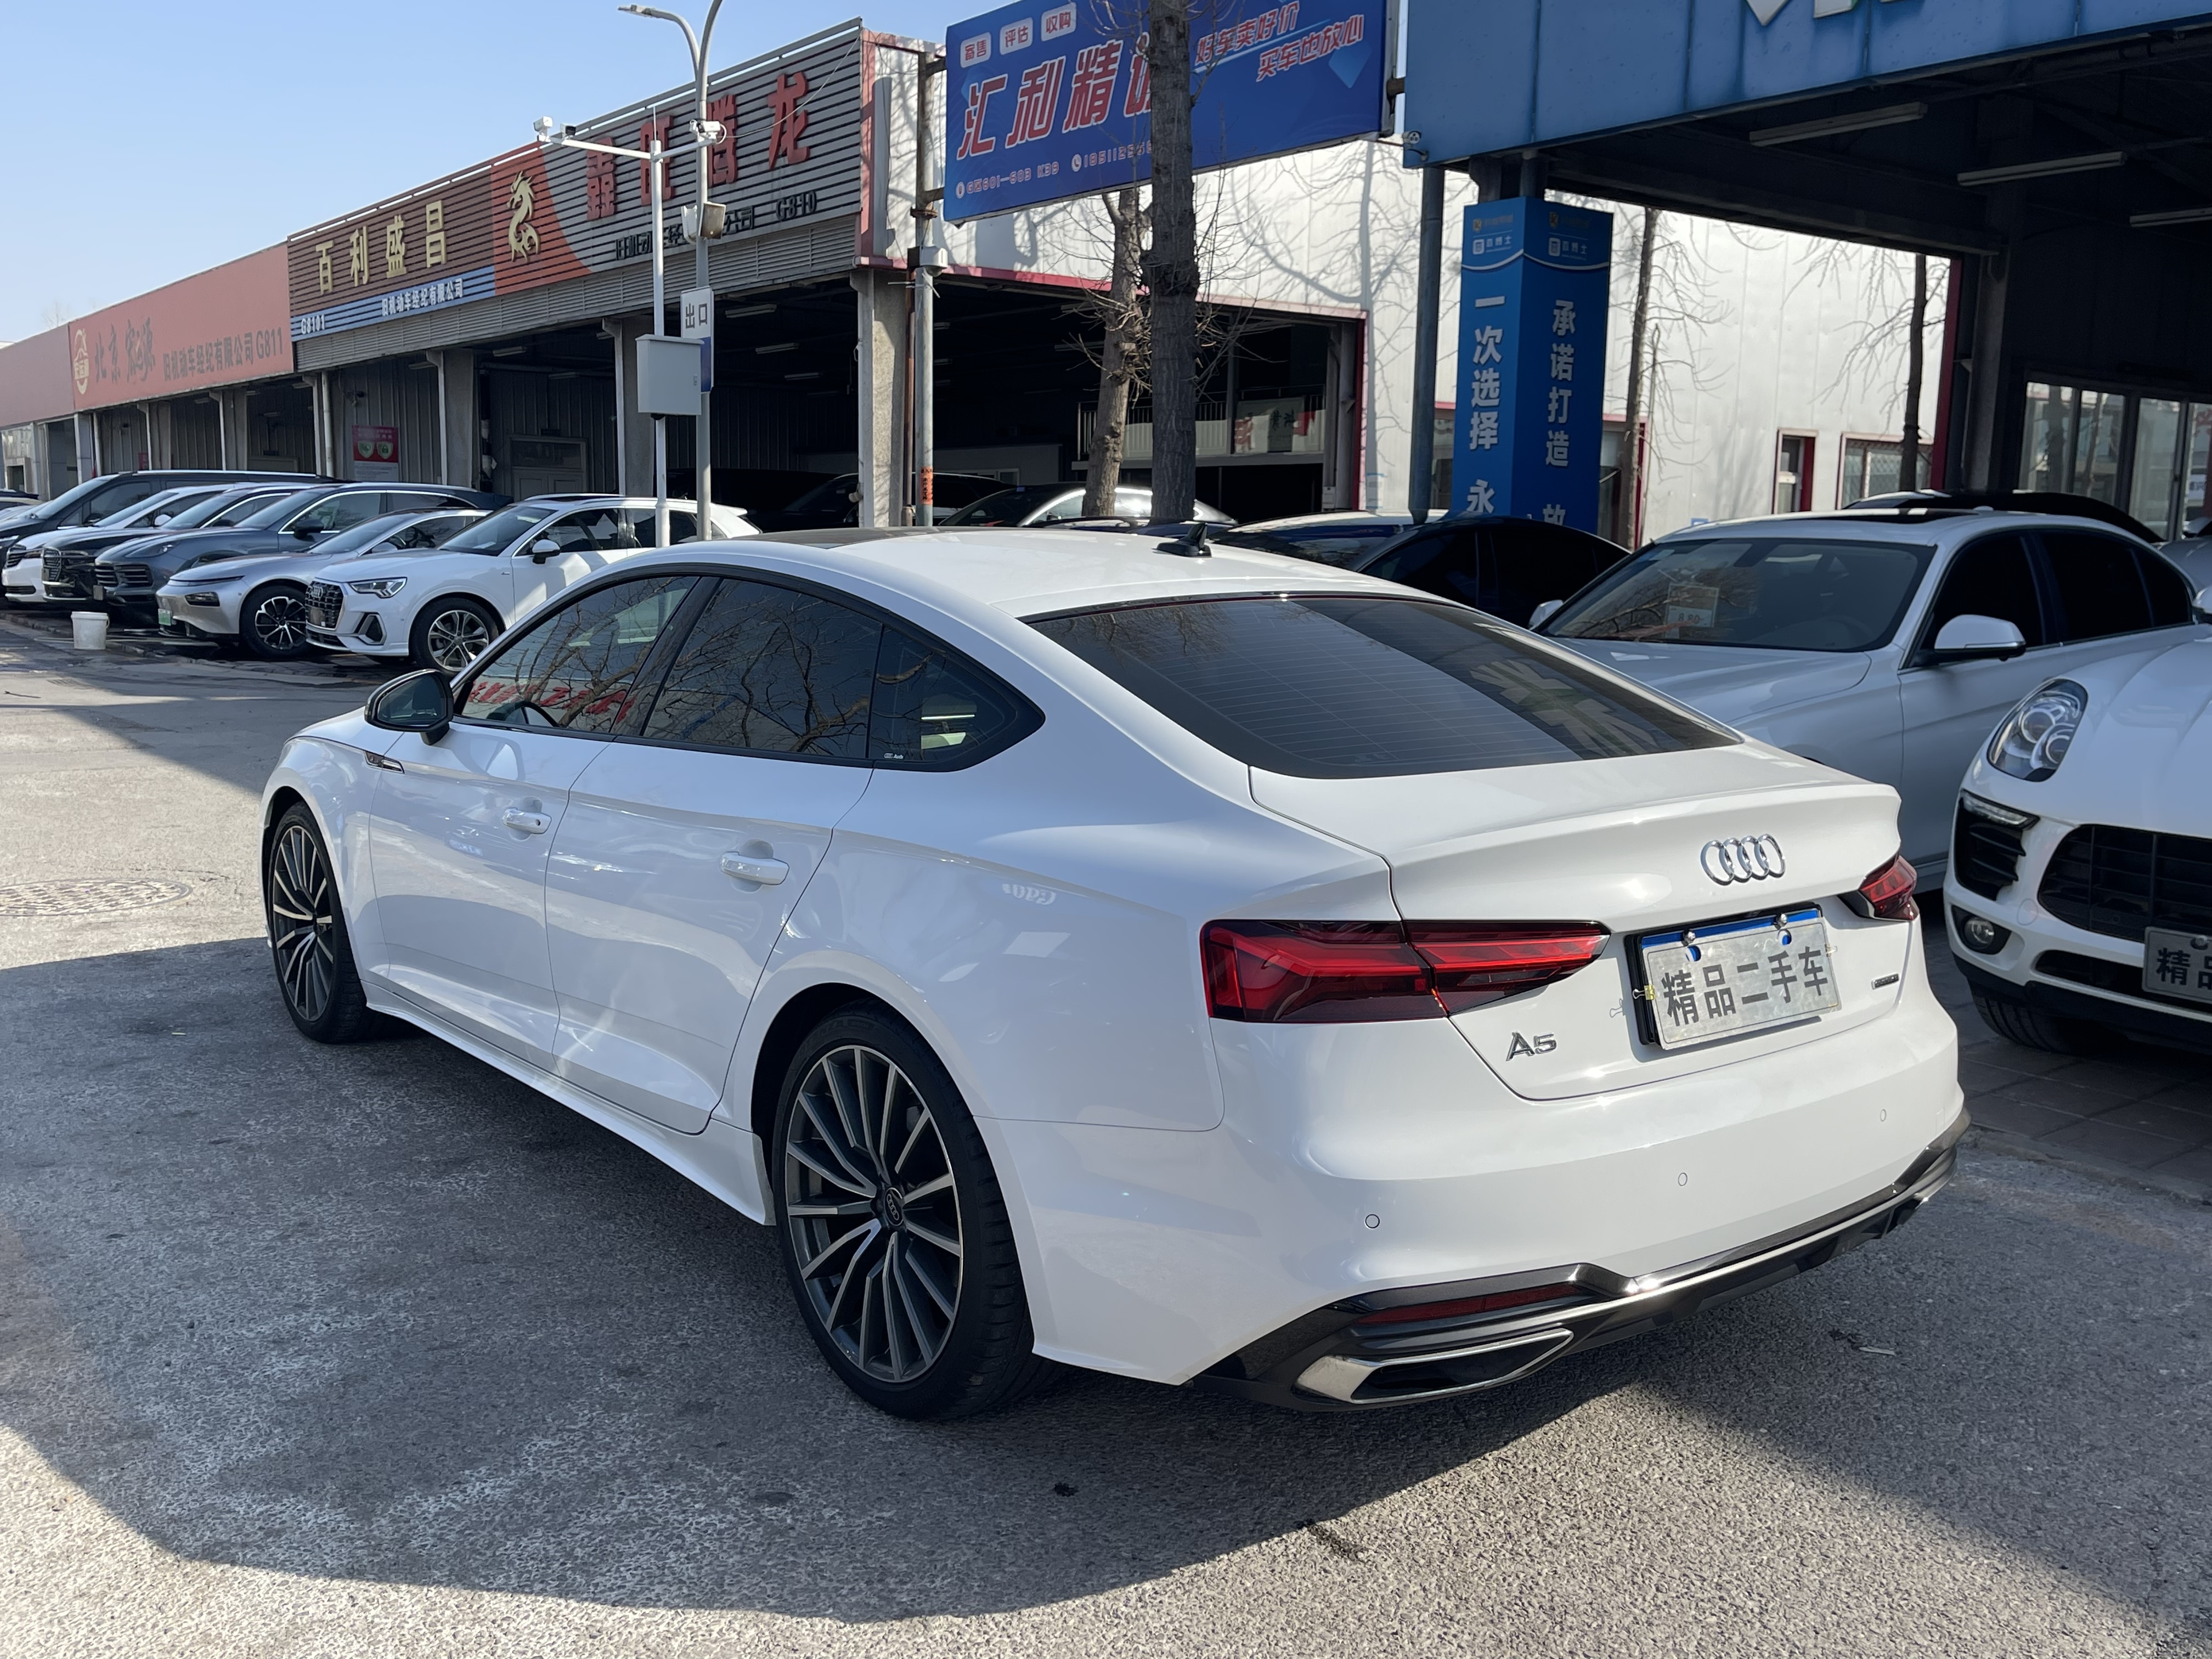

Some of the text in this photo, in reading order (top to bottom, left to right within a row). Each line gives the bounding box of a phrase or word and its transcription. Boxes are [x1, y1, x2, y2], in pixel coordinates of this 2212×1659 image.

[964, 10, 1071, 61] 寄售 评估 收购
[1194, 1, 1300, 66] 好车卖好价
[1256, 14, 1364, 82] 买车也放心
[775, 190, 817, 220] G810
[315, 200, 447, 295] 百利盛昌
[301, 278, 464, 335] G8101 旧机动车经纪有限公司
[685, 303, 708, 329] 出口
[256, 327, 283, 359] G811
[1469, 295, 1505, 449] 一次选择
[1545, 299, 1576, 467] 承诺打造
[1661, 946, 1828, 1026] 精品二手车
[1505, 1032, 1557, 1062] A5
